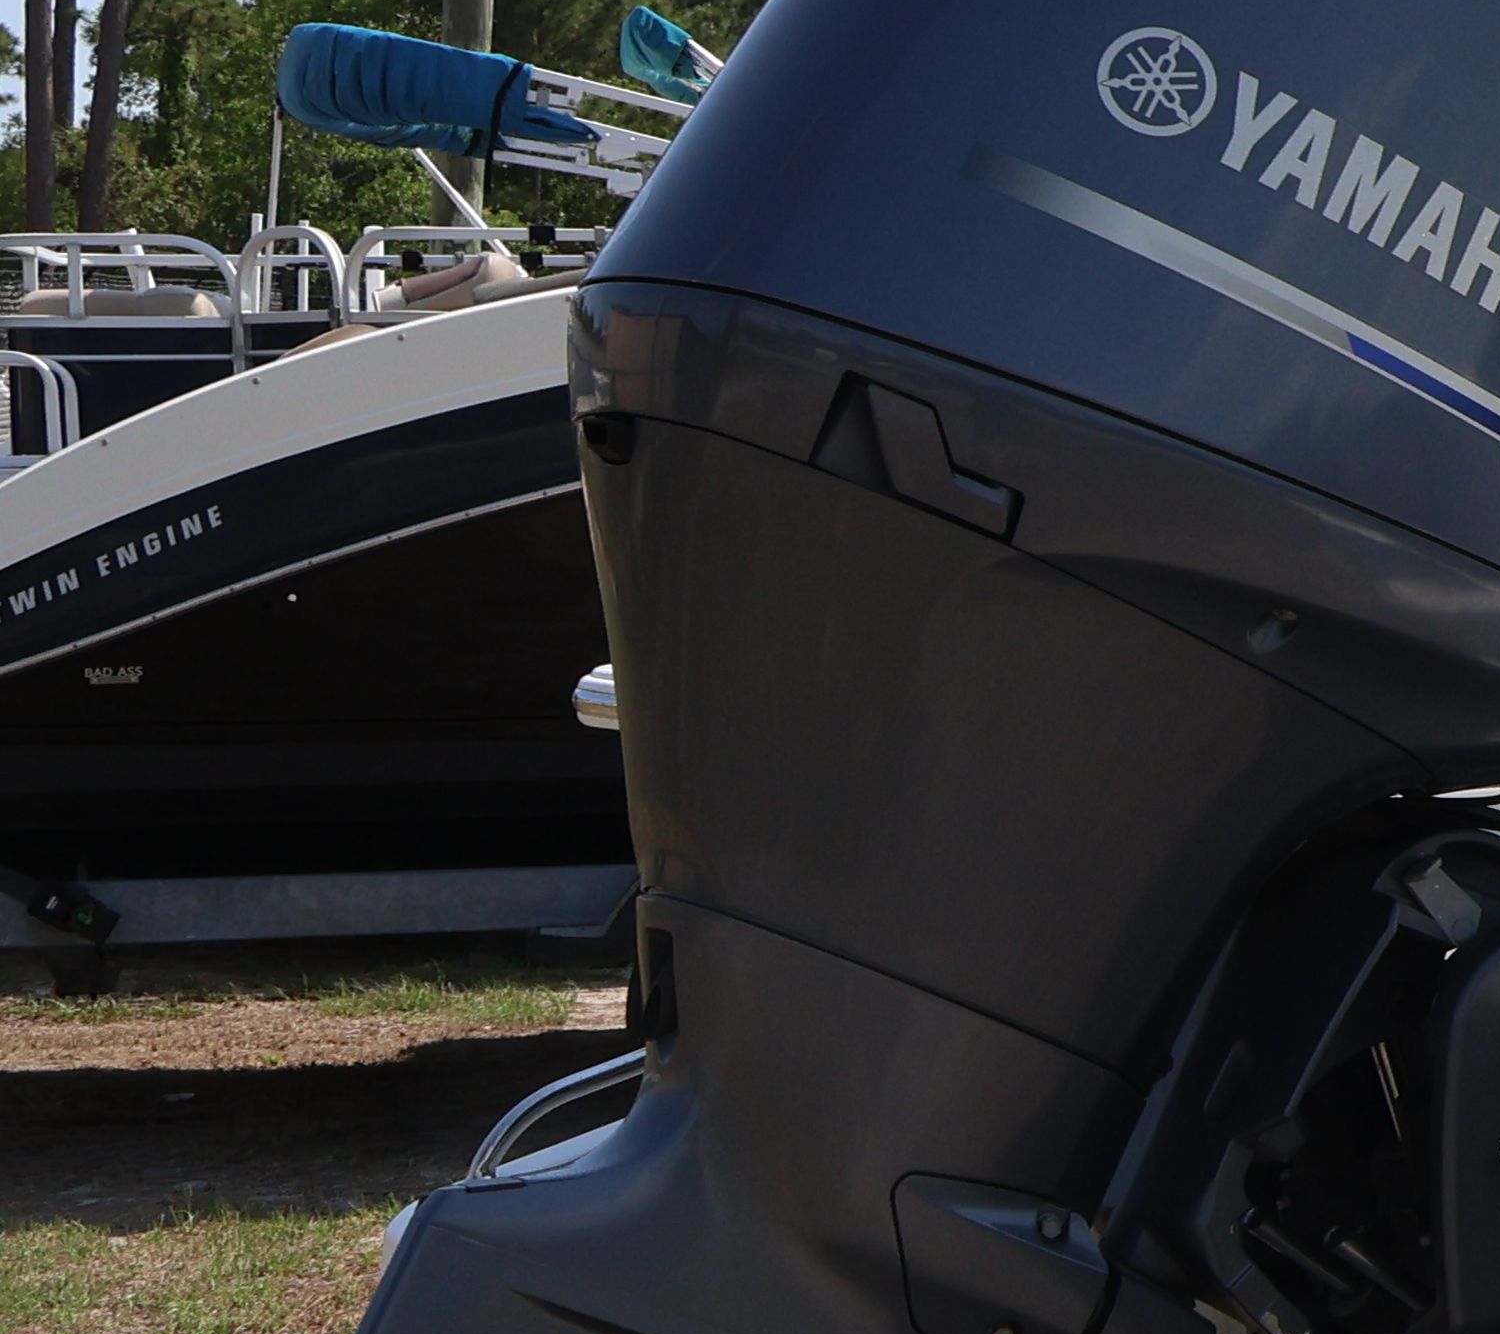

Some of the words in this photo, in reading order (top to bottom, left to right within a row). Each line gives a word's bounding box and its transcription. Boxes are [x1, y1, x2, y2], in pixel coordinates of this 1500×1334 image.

[0, 568, 80, 623] WIN
[96, 505, 222, 577] ENGINE
[84, 667, 112, 678] BAD
[117, 666, 143, 676] ASS
